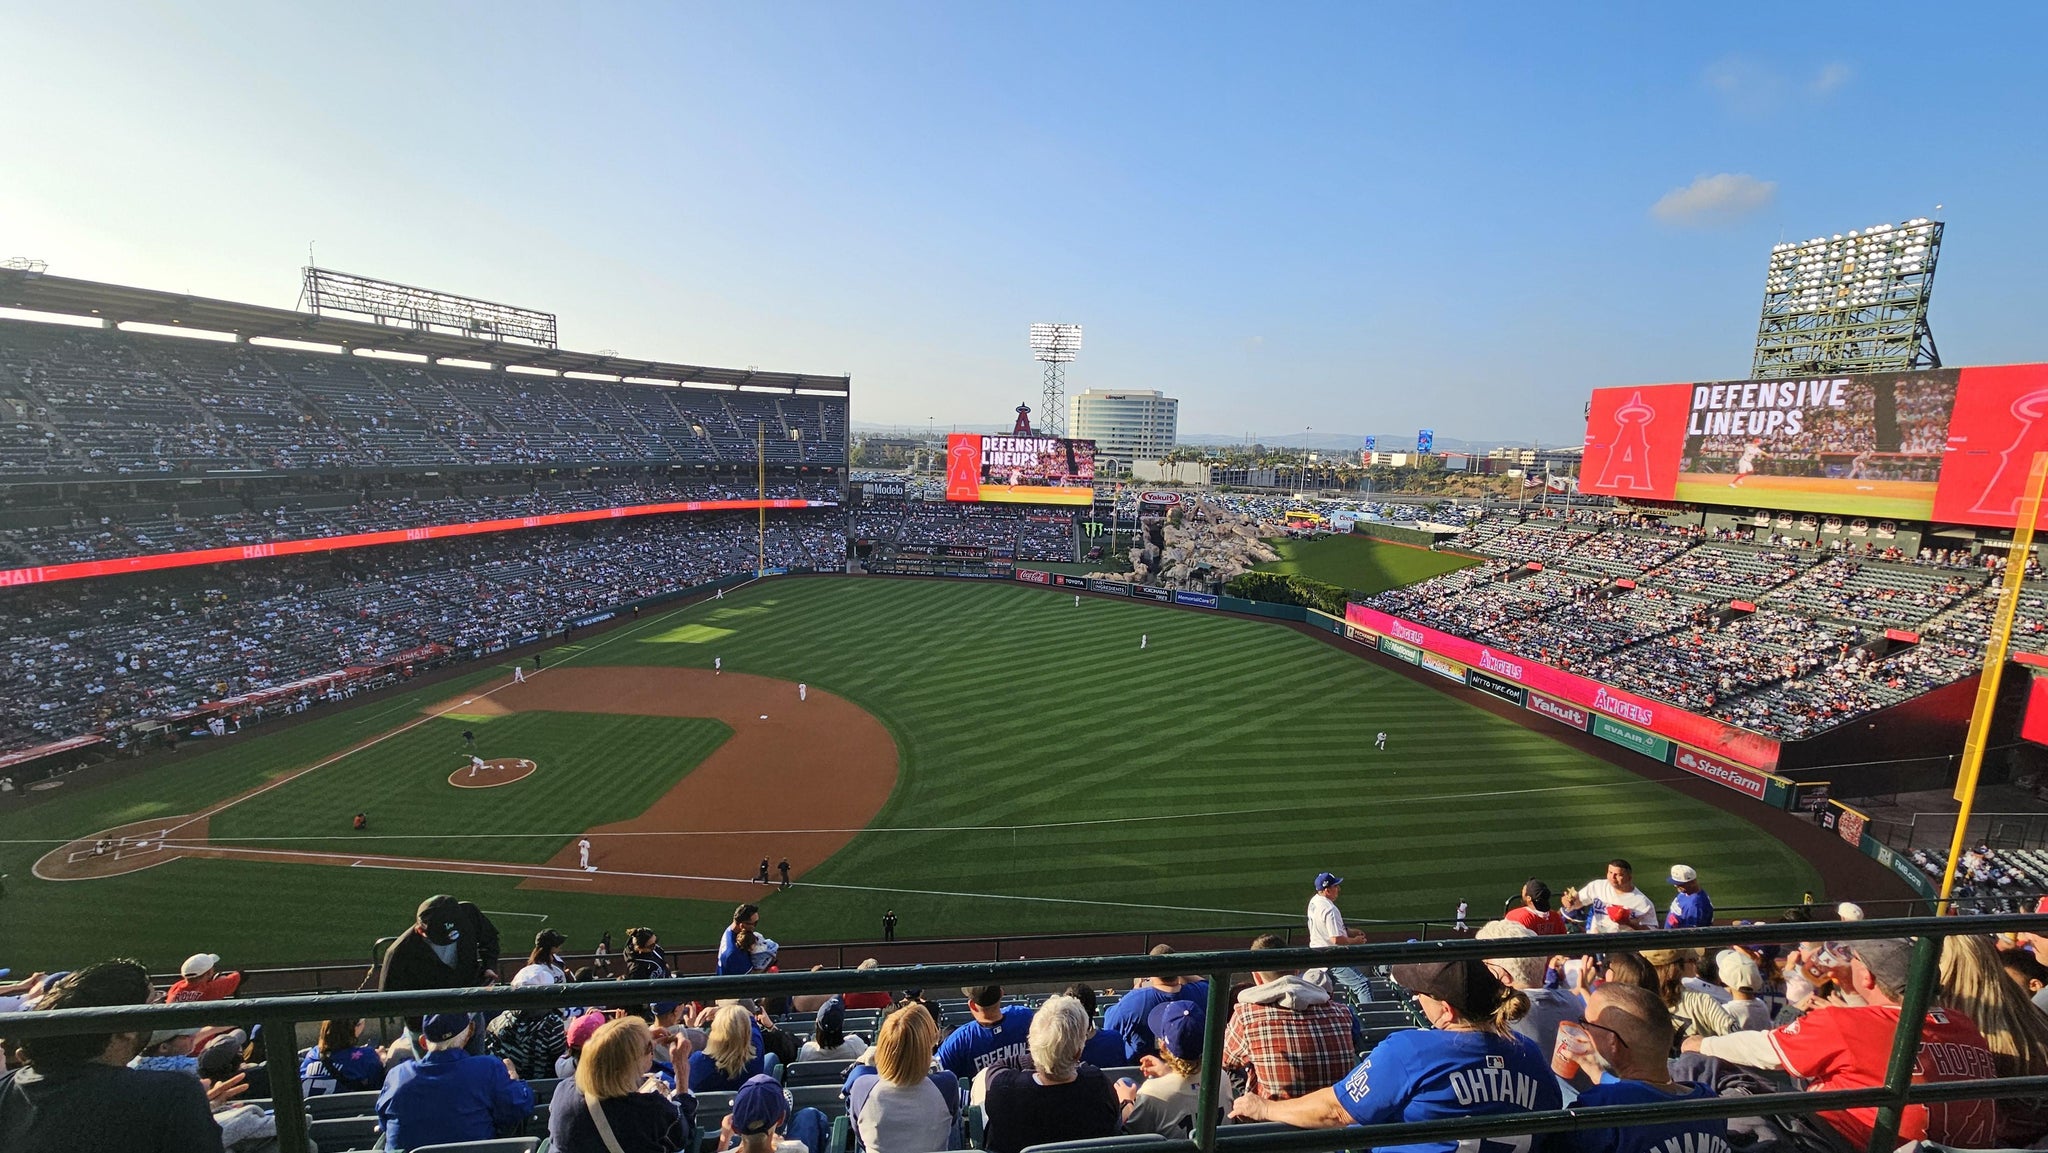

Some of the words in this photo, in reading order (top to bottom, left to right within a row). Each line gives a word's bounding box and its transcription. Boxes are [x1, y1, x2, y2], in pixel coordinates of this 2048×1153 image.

[1693, 379, 1849, 409] DEFENSIVE
[1689, 409, 1803, 436] LINEUPS
[982, 437, 1056, 453] DEFENSIVE
[981, 452, 1038, 466] LINEUPS
[874, 483, 903, 495] Modelo
[1780, 514, 1791, 522] 26
[1803, 516, 1815, 524] 29
[1828, 517, 1840, 526] 30
[1852, 519, 1866, 528] 42
[1880, 522, 1894, 532] 50
[1020, 570, 1044, 582] Coca-Cola
[1066, 578, 1083, 586] TOYOTA
[1143, 587, 1168, 596] YOKOHAMA
[1391, 620, 1424, 645] ANGELS
[1391, 643, 1415, 658] National
[1480, 649, 1522, 680] ANGELS
[1473, 674, 1490, 687] NITTO
[1532, 695, 1583, 724] Yakult
[1594, 688, 1652, 726] ANGELS
[1894, 859, 1922, 887] FMB.com
[973, 1042, 1026, 1071] FREEMAN
[1449, 1067, 1538, 1110] OHTANI
